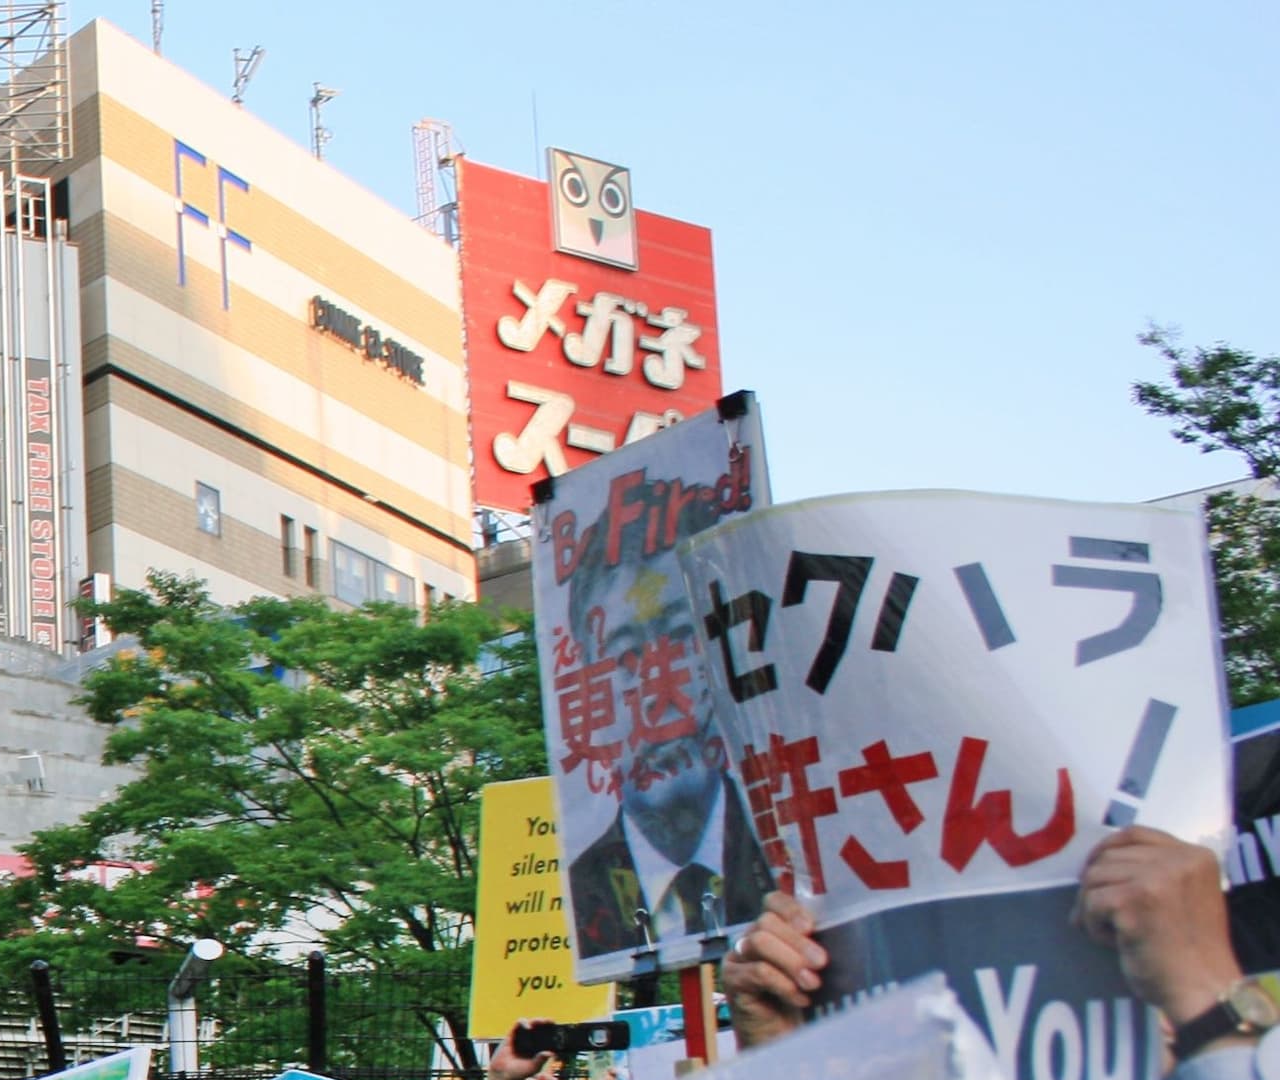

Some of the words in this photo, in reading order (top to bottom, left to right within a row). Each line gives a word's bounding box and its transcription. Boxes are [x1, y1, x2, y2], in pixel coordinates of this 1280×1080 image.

[496, 277, 707, 391] メガネ
[27, 377, 51, 434] TAX
[28, 442, 54, 512] FREE
[30, 519, 54, 618] STORE
[701, 534, 1164, 704] セクハラ
[553, 634, 699, 775] 更迭
[741, 698, 1178, 898] 許さん!
[505, 892, 545, 915] will
[511, 854, 559, 877] silen
[516, 973, 563, 997] you.
